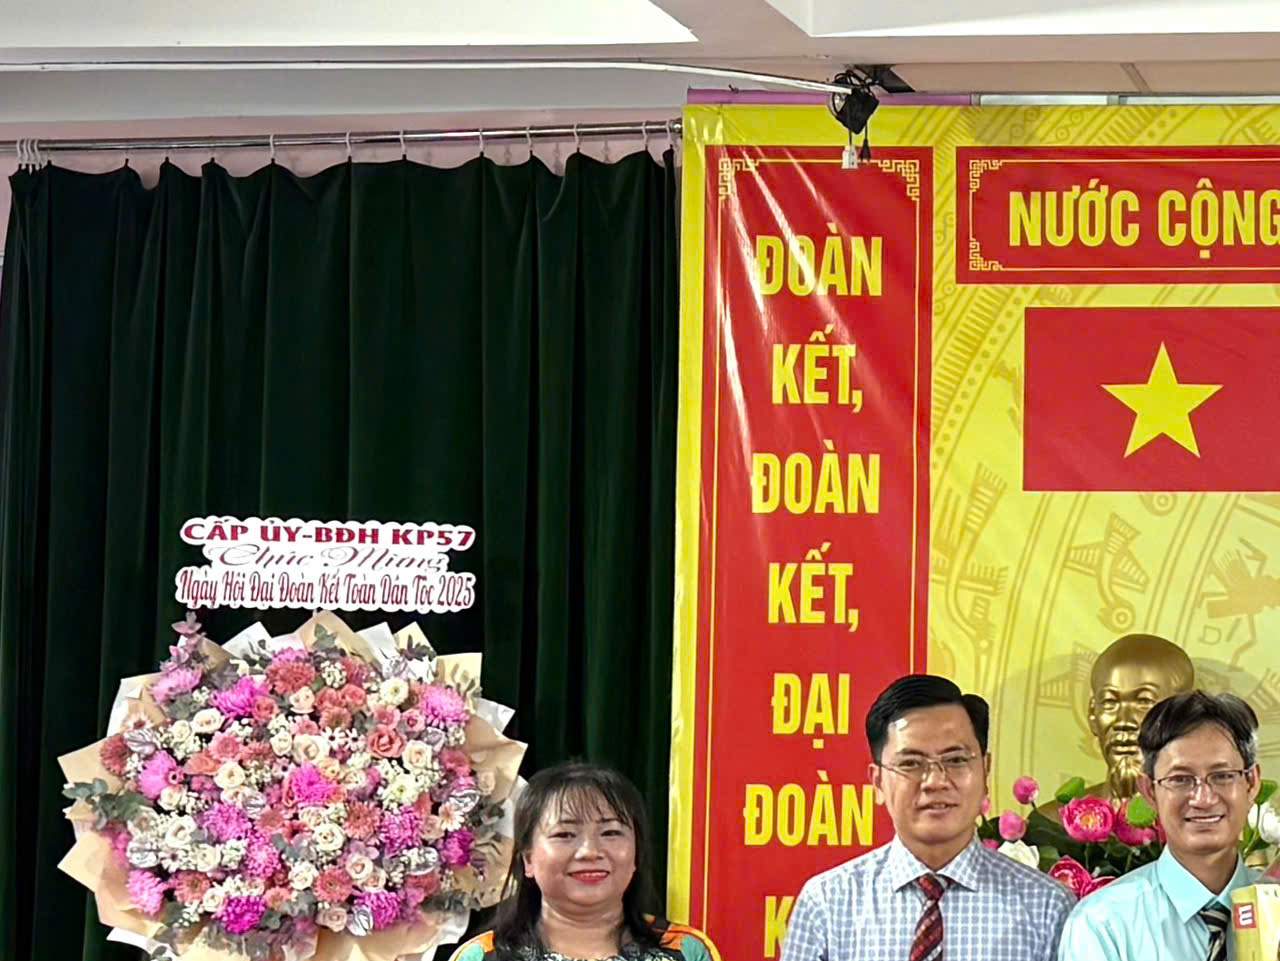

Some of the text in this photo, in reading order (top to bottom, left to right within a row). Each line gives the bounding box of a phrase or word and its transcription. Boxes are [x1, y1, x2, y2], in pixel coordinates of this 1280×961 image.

[1008, 177, 1140, 248] NƯỚC
[753, 223, 883, 297] ĐOÀN
[771, 324, 864, 412] KẾT,
[751, 439, 881, 515] ĐOÀN
[183, 518, 249, 542] CẤP
[391, 527, 474, 547] KP57
[436, 574, 474, 607] 2025
[768, 542, 860, 630] KẾT,
[771, 672, 851, 749] ĐẠI
[743, 770, 874, 846] ĐOÀN
